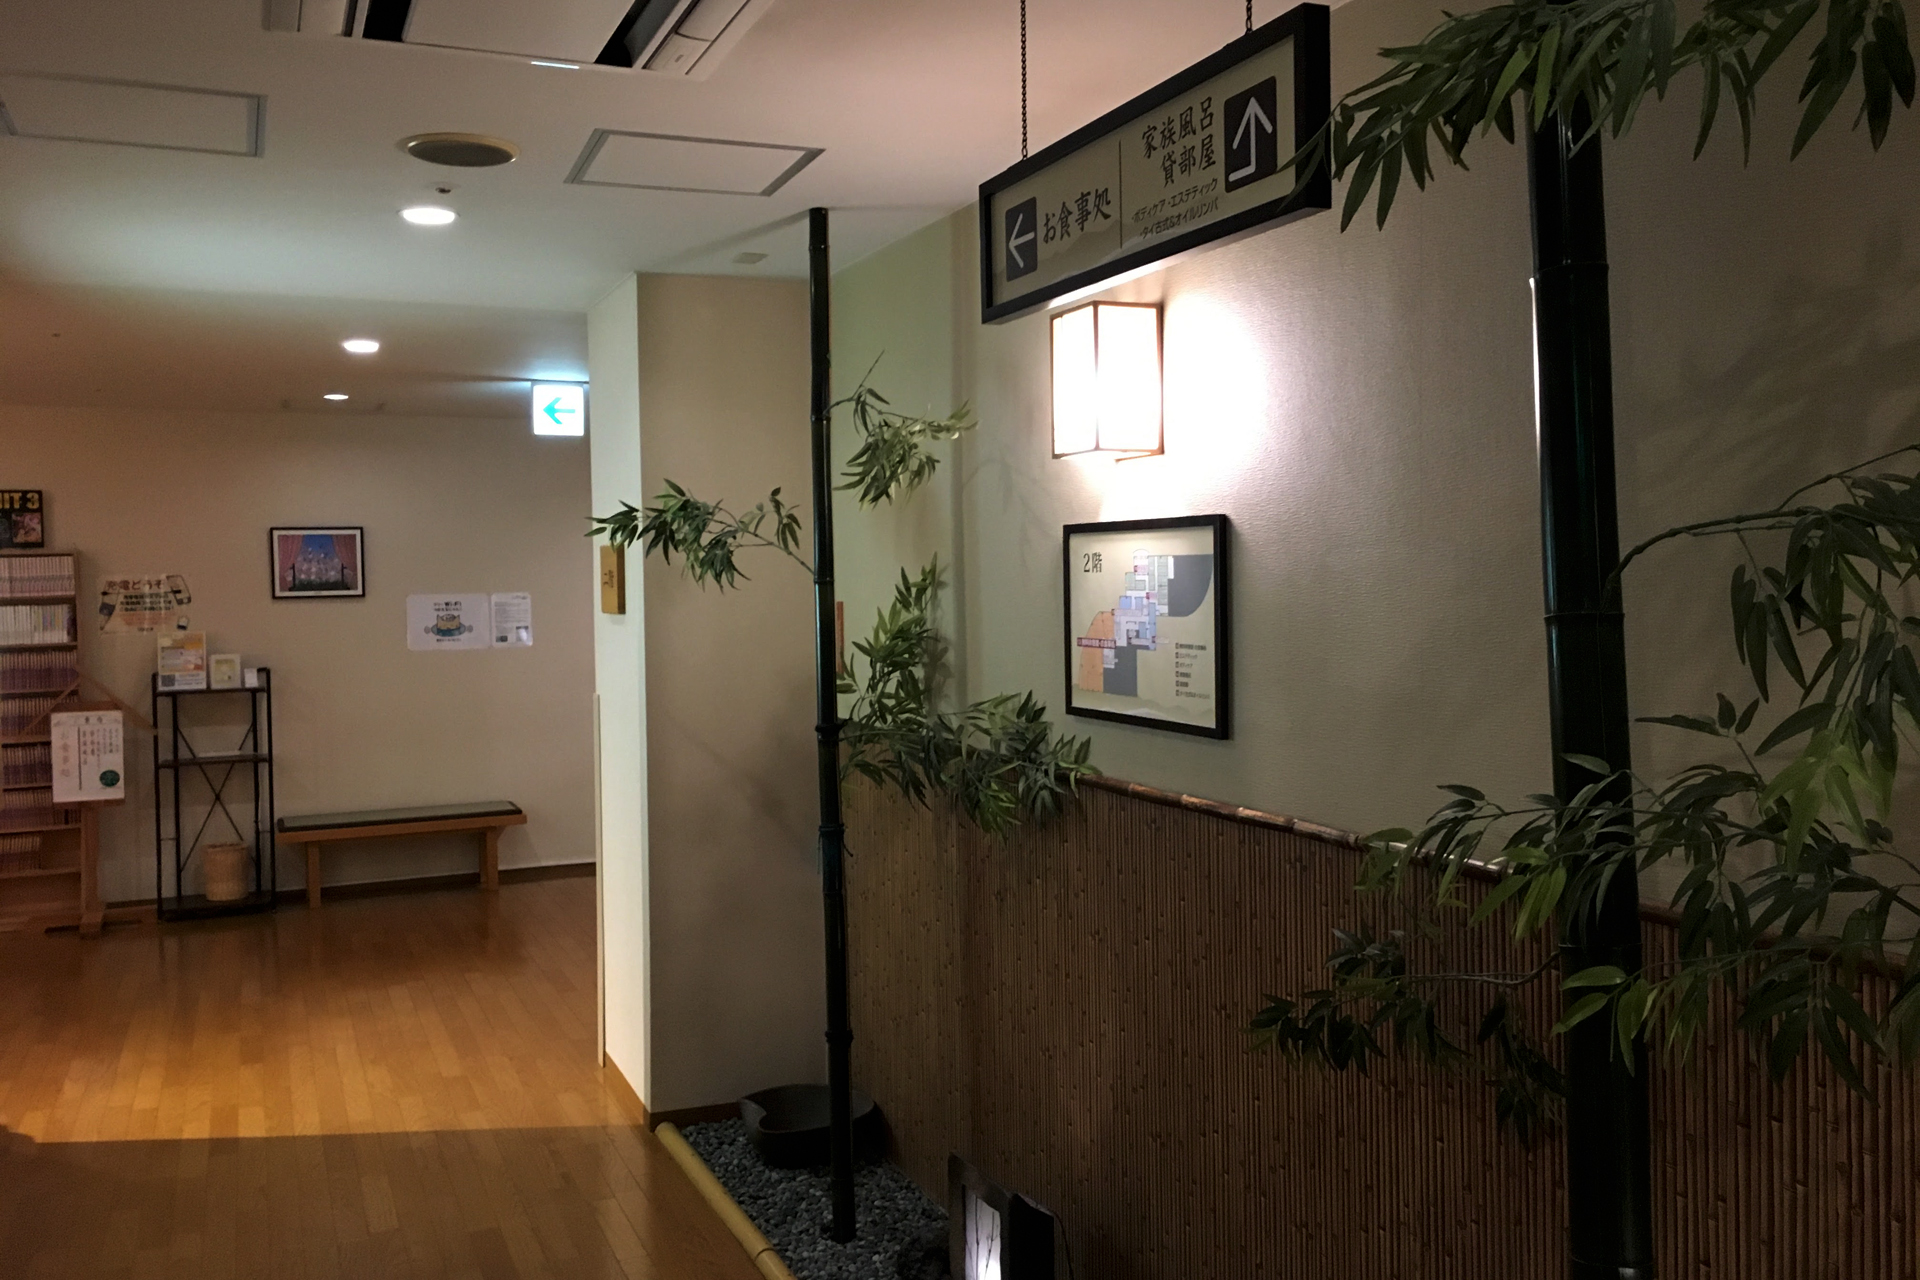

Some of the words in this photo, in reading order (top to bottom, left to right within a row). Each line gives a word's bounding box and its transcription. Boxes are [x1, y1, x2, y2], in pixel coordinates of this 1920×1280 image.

[1141, 96, 1213, 160] 家族風呂
[1159, 133, 1217, 188] 貸部屋
[1042, 187, 1112, 244] お食事処
[26, 492, 40, 509] 3
[1083, 552, 1103, 573] 2階
